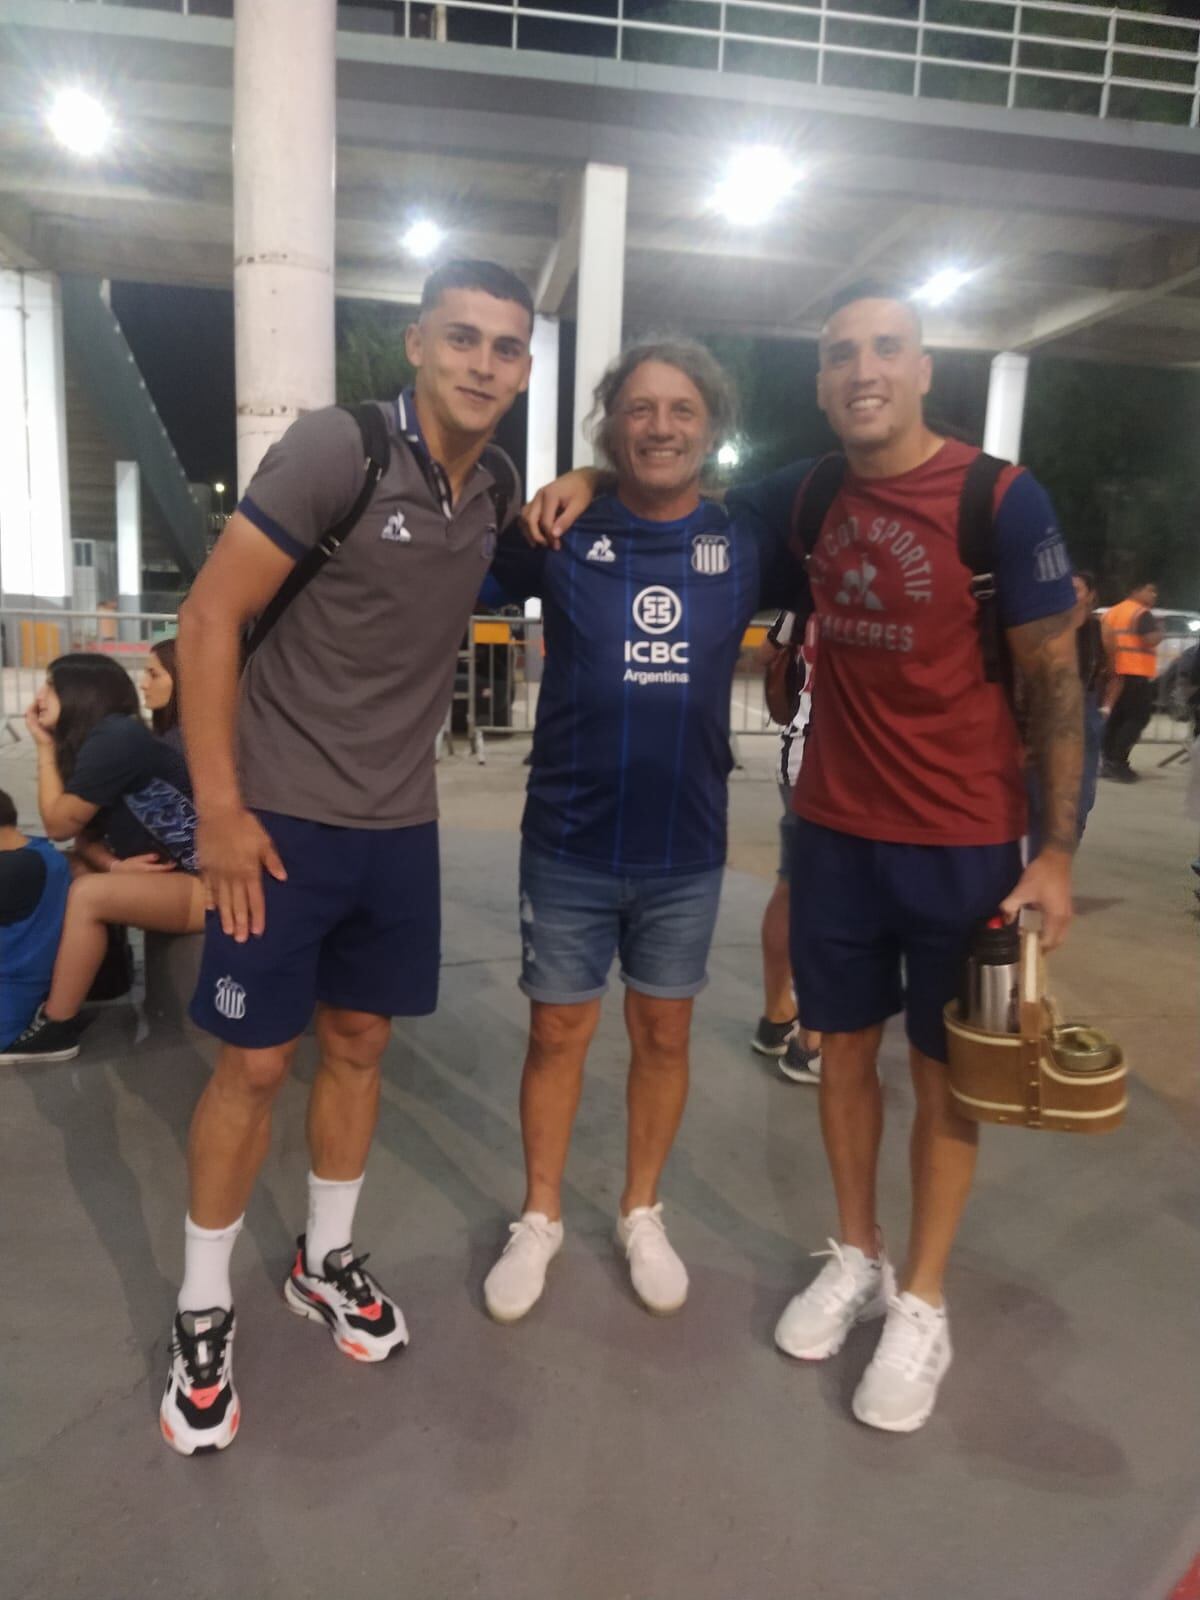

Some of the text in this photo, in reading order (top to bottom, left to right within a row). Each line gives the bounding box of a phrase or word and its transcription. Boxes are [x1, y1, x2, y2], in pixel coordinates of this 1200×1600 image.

[867, 516, 933, 604] SPORTIF
[624, 640, 690, 664] ICBC
[623, 667, 690, 685] Argentina
